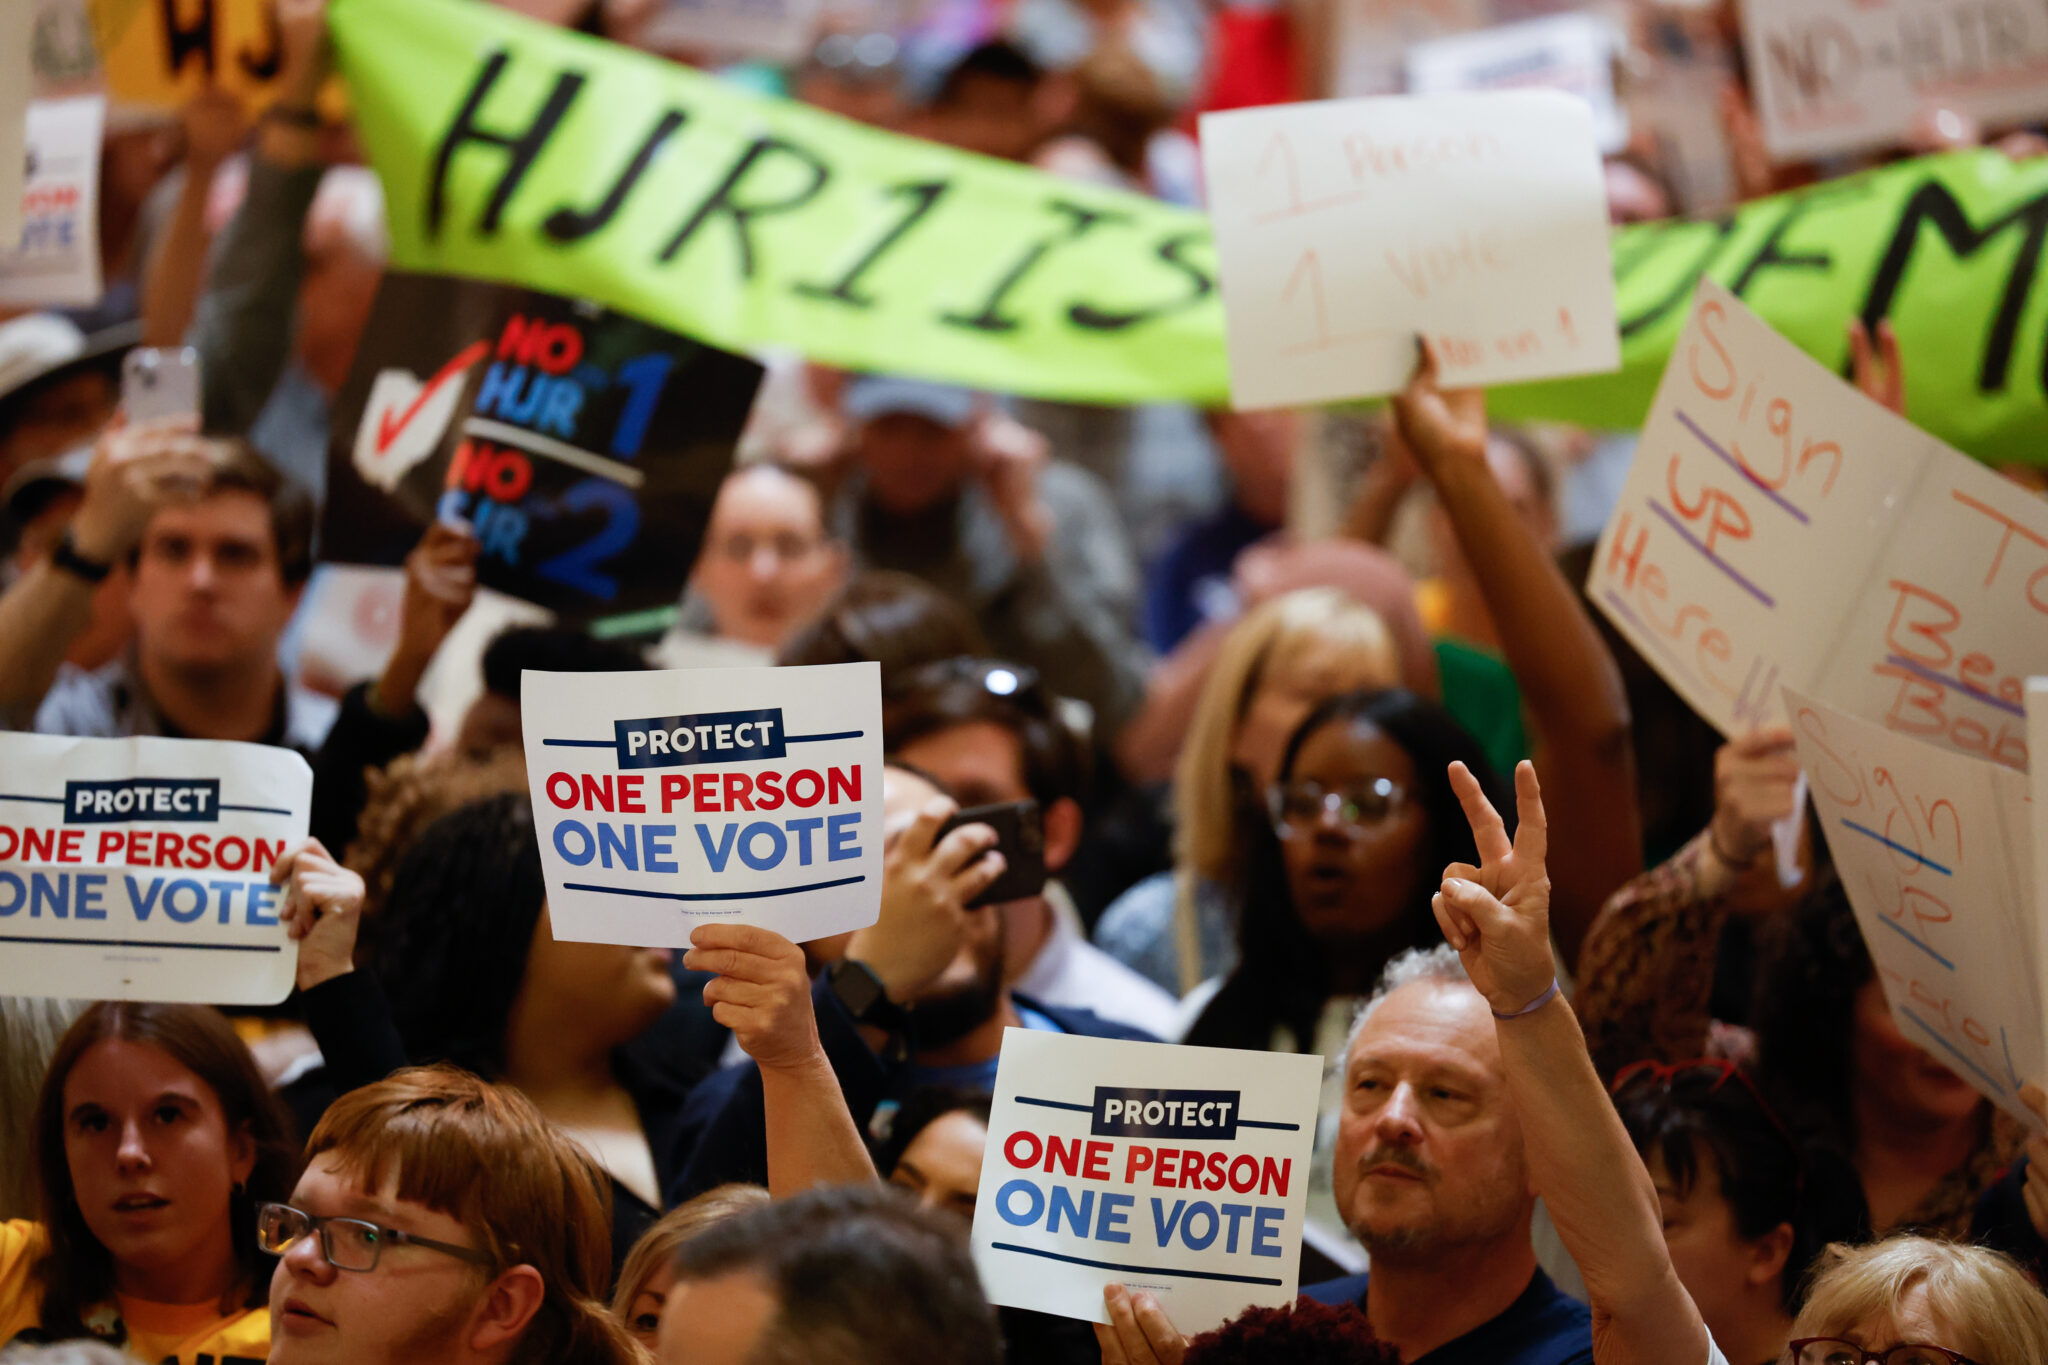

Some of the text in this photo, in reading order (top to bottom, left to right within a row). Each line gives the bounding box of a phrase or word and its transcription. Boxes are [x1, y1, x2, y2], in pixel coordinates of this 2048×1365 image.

[497, 312, 584, 375] NO
[1689, 300, 1843, 497] Sign
[445, 440, 533, 502] NO
[627, 720, 774, 756] PROTECT
[74, 787, 212, 815] PROTECT
[546, 764, 862, 814] ONE PERSON
[96, 829, 287, 873] PERSON
[552, 812, 863, 874] ONE VOTE
[124, 876, 283, 926] VOTE
[1103, 1098, 1233, 1128] PROTECT
[1003, 1130, 1292, 1198] ONE PERSON
[995, 1178, 1286, 1258] ONE VOTE
